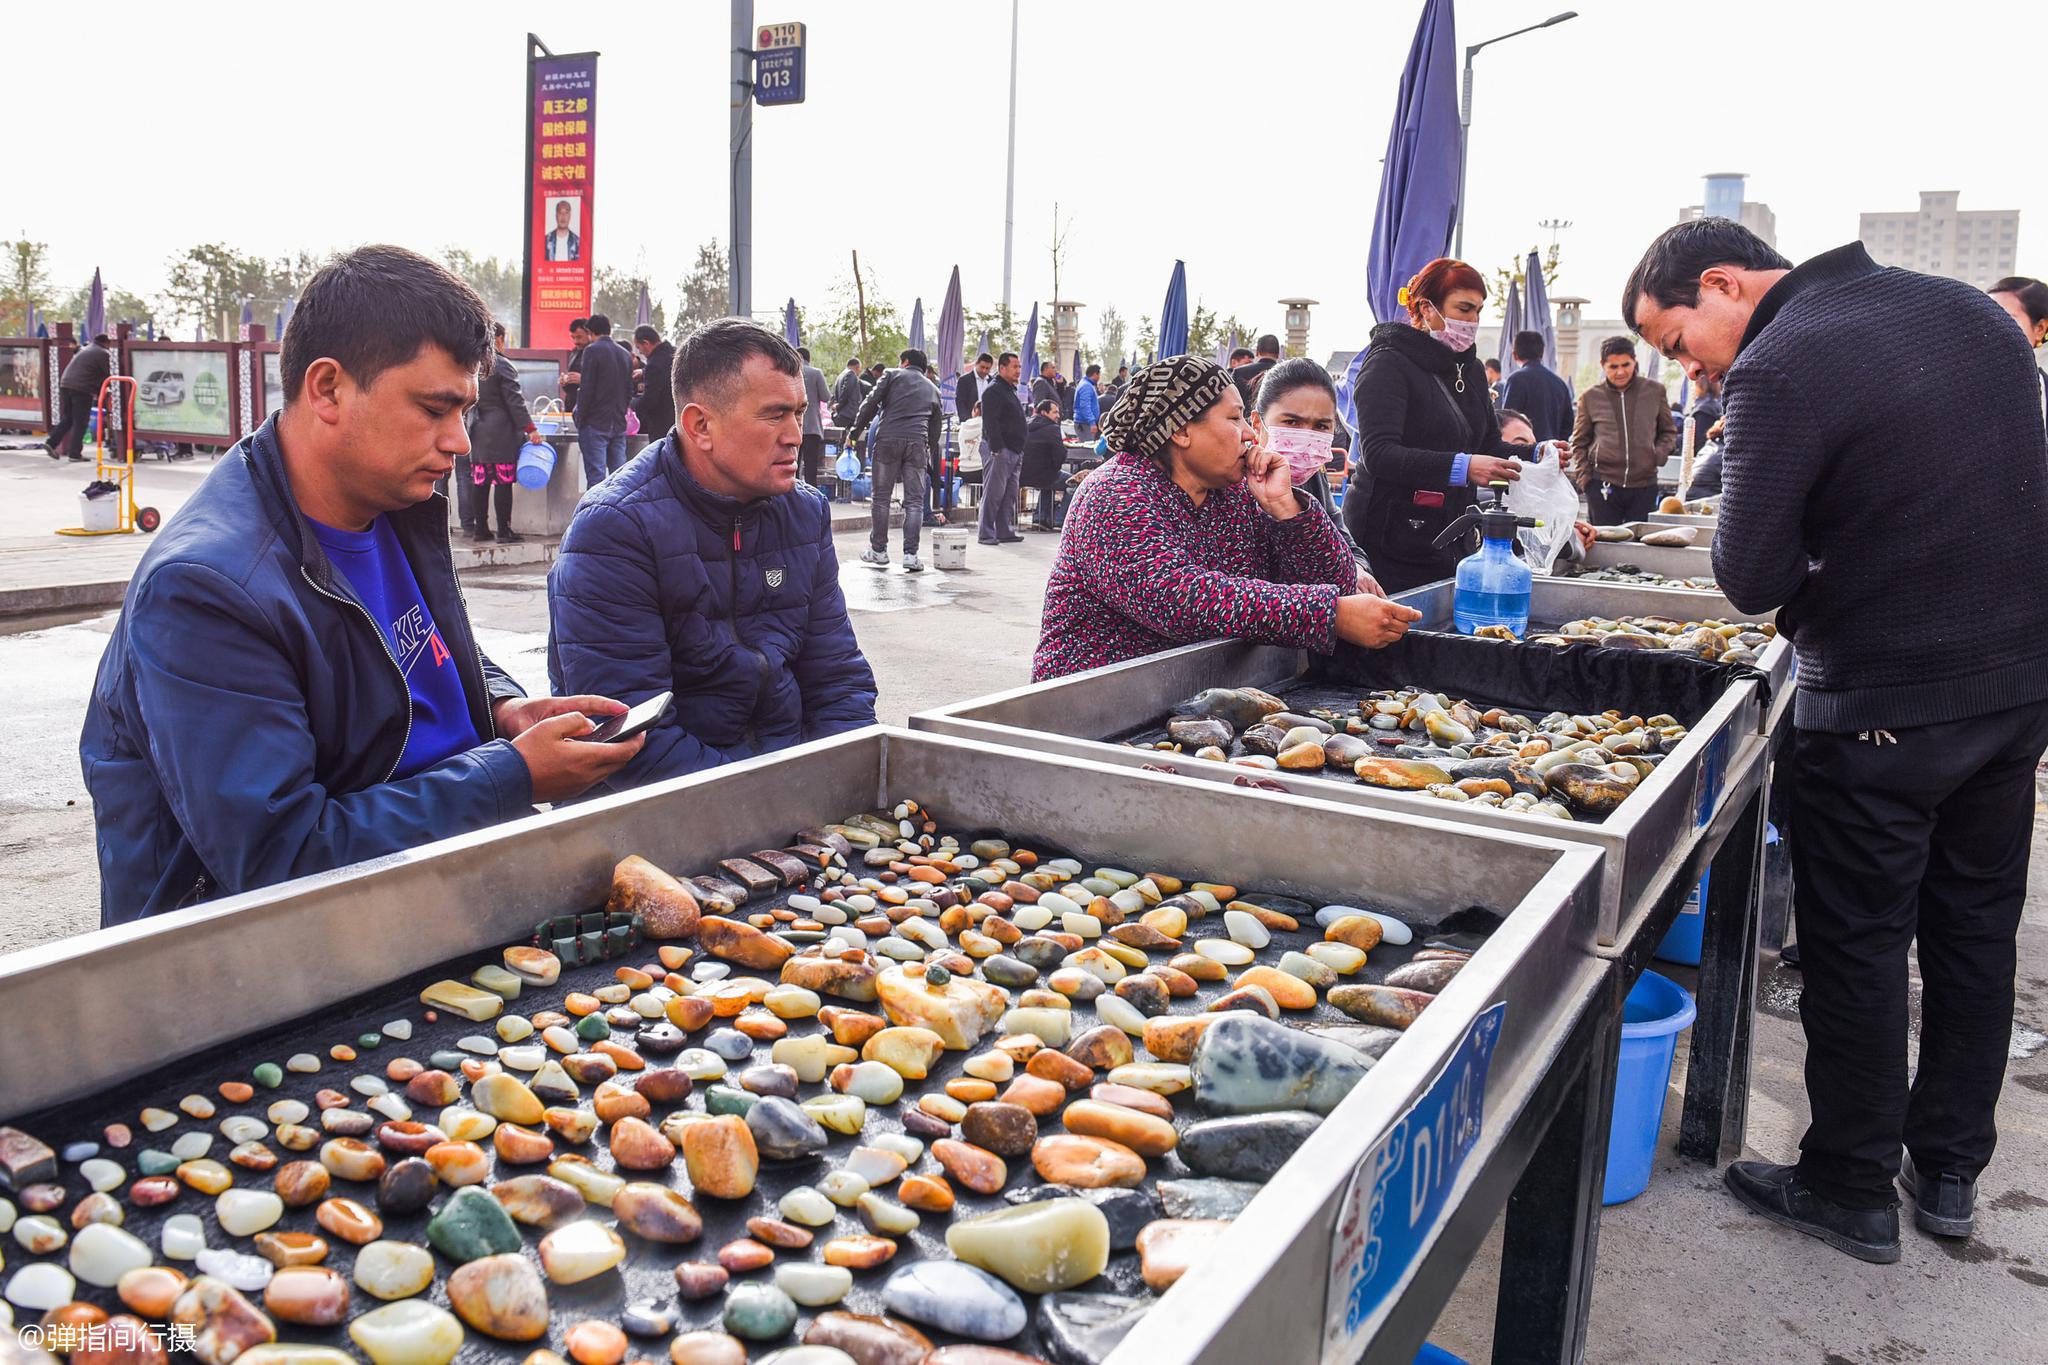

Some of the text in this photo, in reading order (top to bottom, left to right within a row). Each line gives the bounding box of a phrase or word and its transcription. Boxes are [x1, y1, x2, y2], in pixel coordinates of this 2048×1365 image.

[774, 24, 795, 36] 110
[761, 69, 790, 89] 013
[543, 98, 587, 114] 真玉之都
[543, 120, 586, 136] 国检保障
[542, 143, 586, 157] 假货包退
[541, 165, 586, 180] 诚实守信
[392, 604, 424, 657] KE
